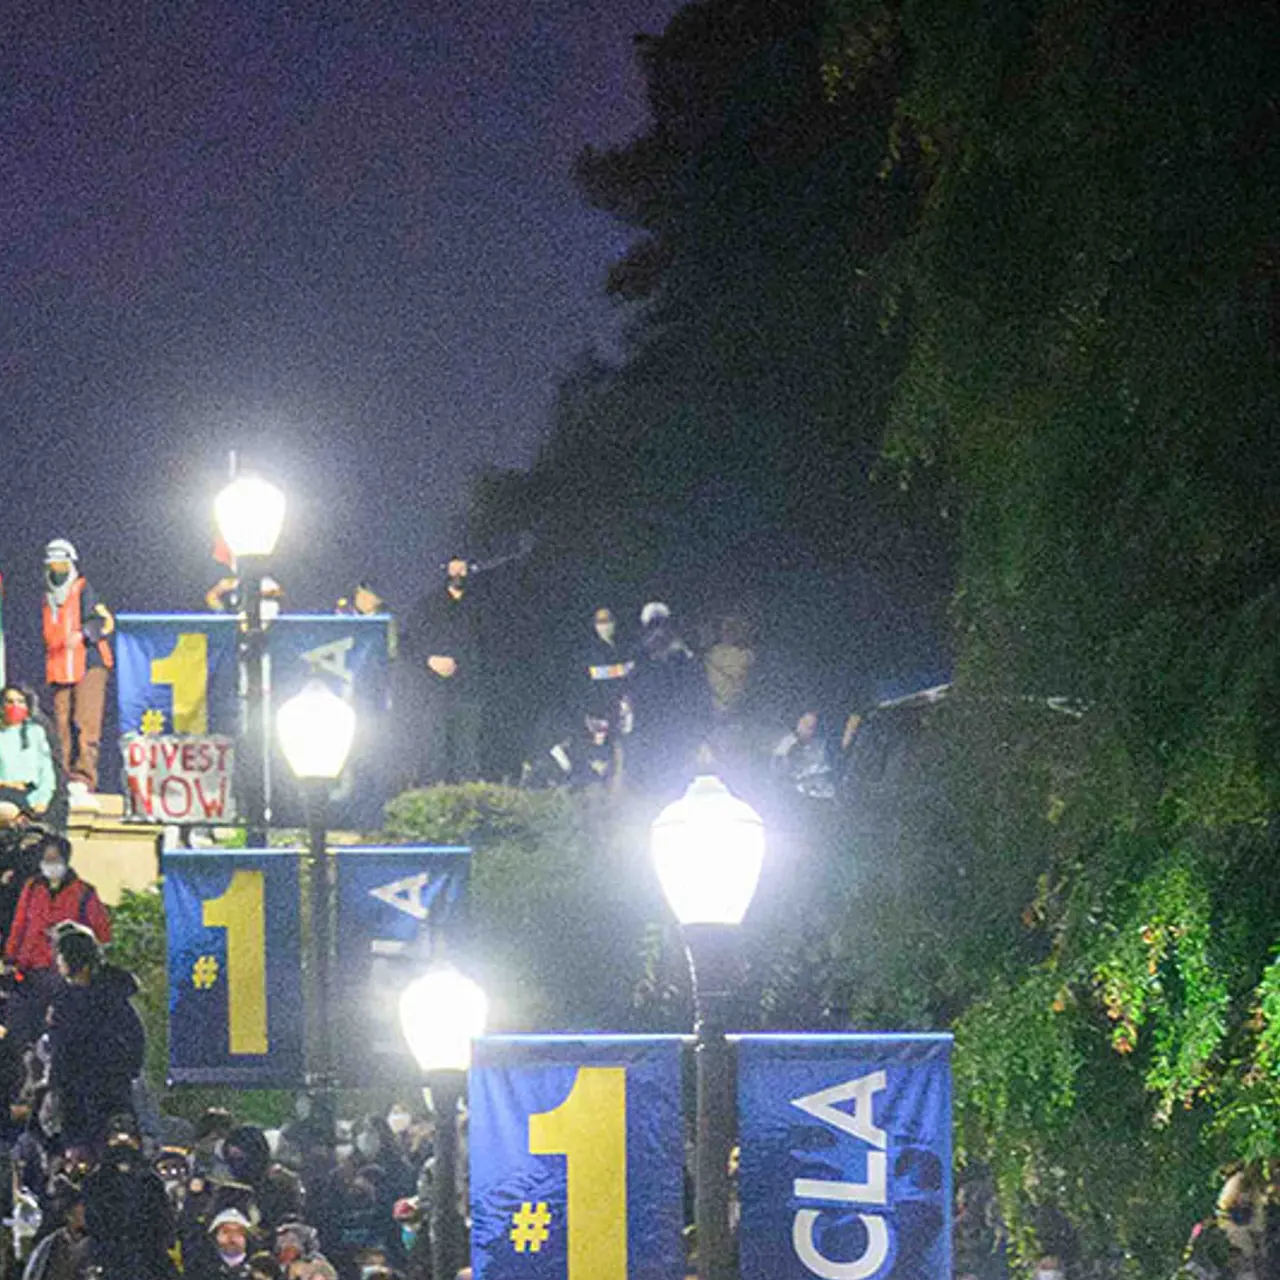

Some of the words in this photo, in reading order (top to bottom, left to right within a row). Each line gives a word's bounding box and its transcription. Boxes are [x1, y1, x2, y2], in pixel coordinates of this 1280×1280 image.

[127, 742, 229, 772] DIVEST
[127, 774, 227, 818] NOW
[192, 871, 269, 1055] #1
